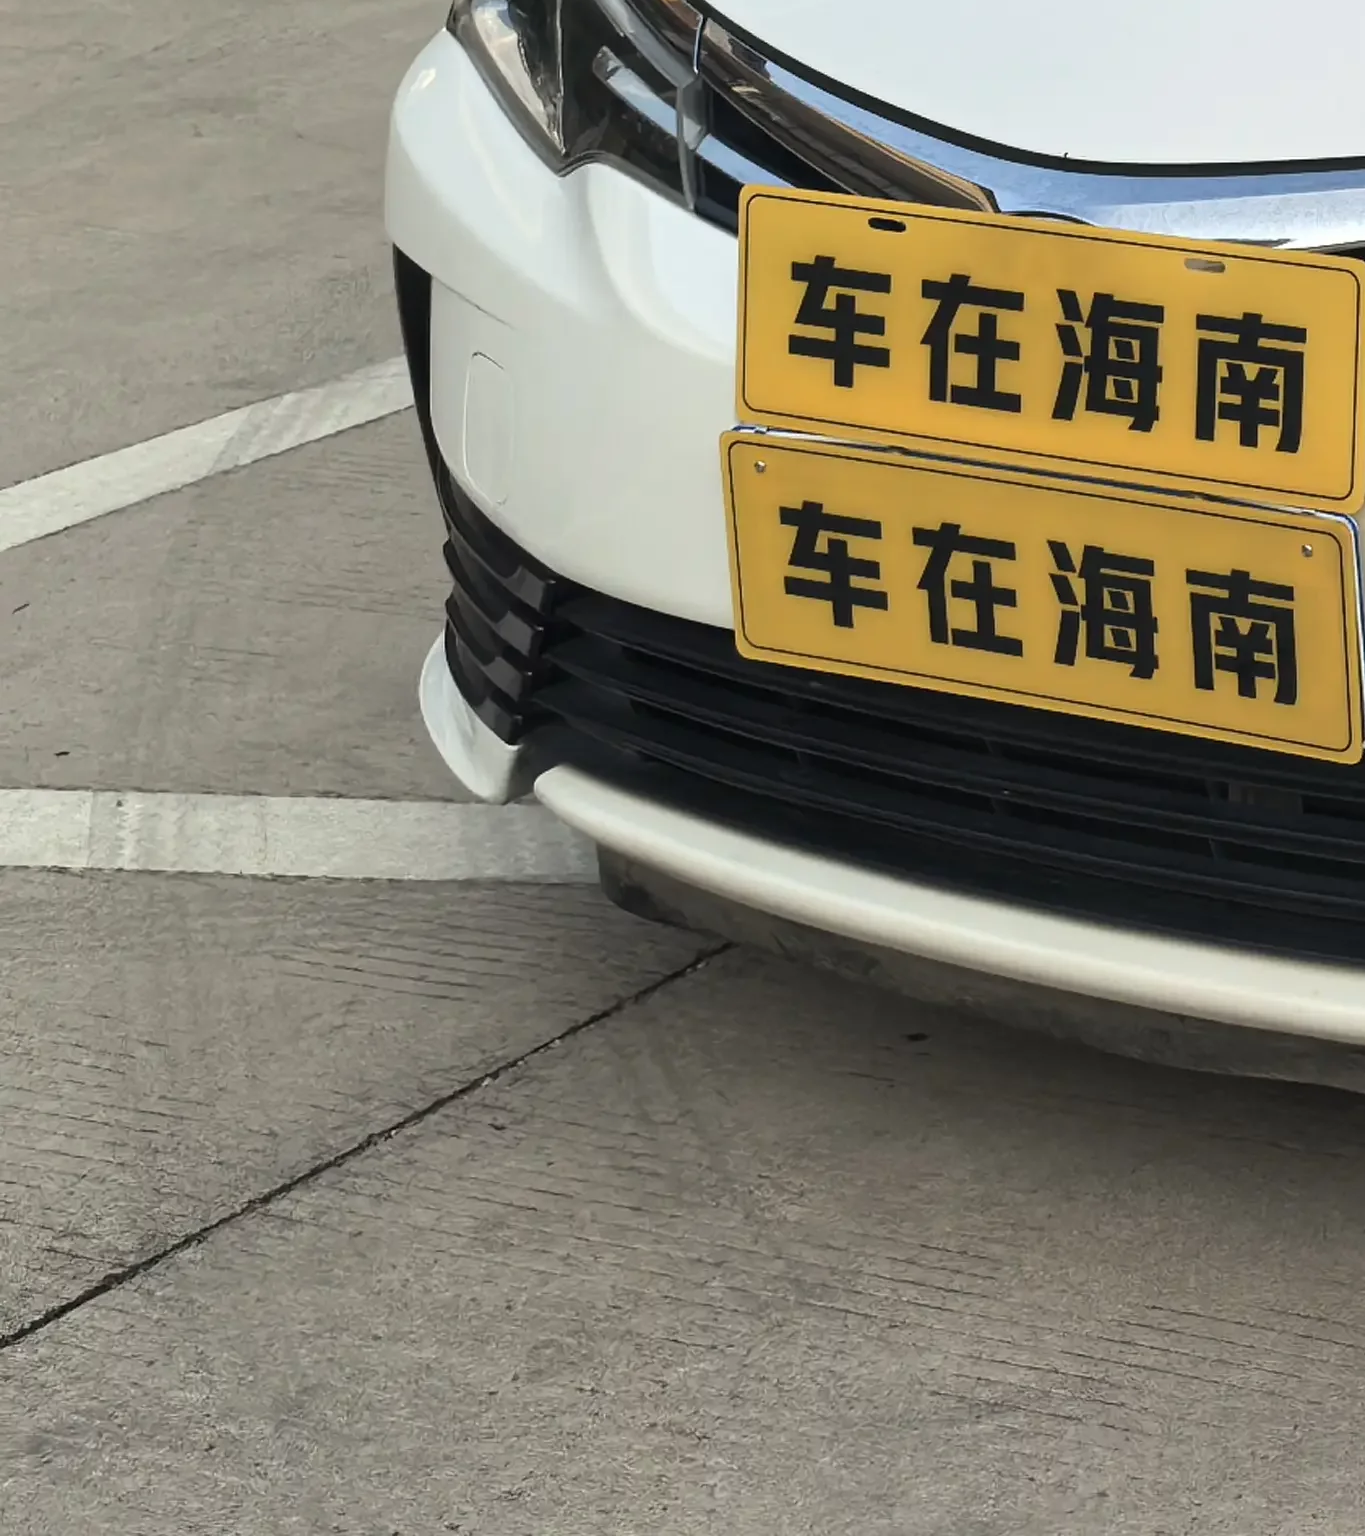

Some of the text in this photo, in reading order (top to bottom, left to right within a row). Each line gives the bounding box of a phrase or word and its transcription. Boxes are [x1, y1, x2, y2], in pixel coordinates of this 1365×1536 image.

[788, 255, 1307, 453] 车在海南
[779, 500, 1297, 705] 车在海南
